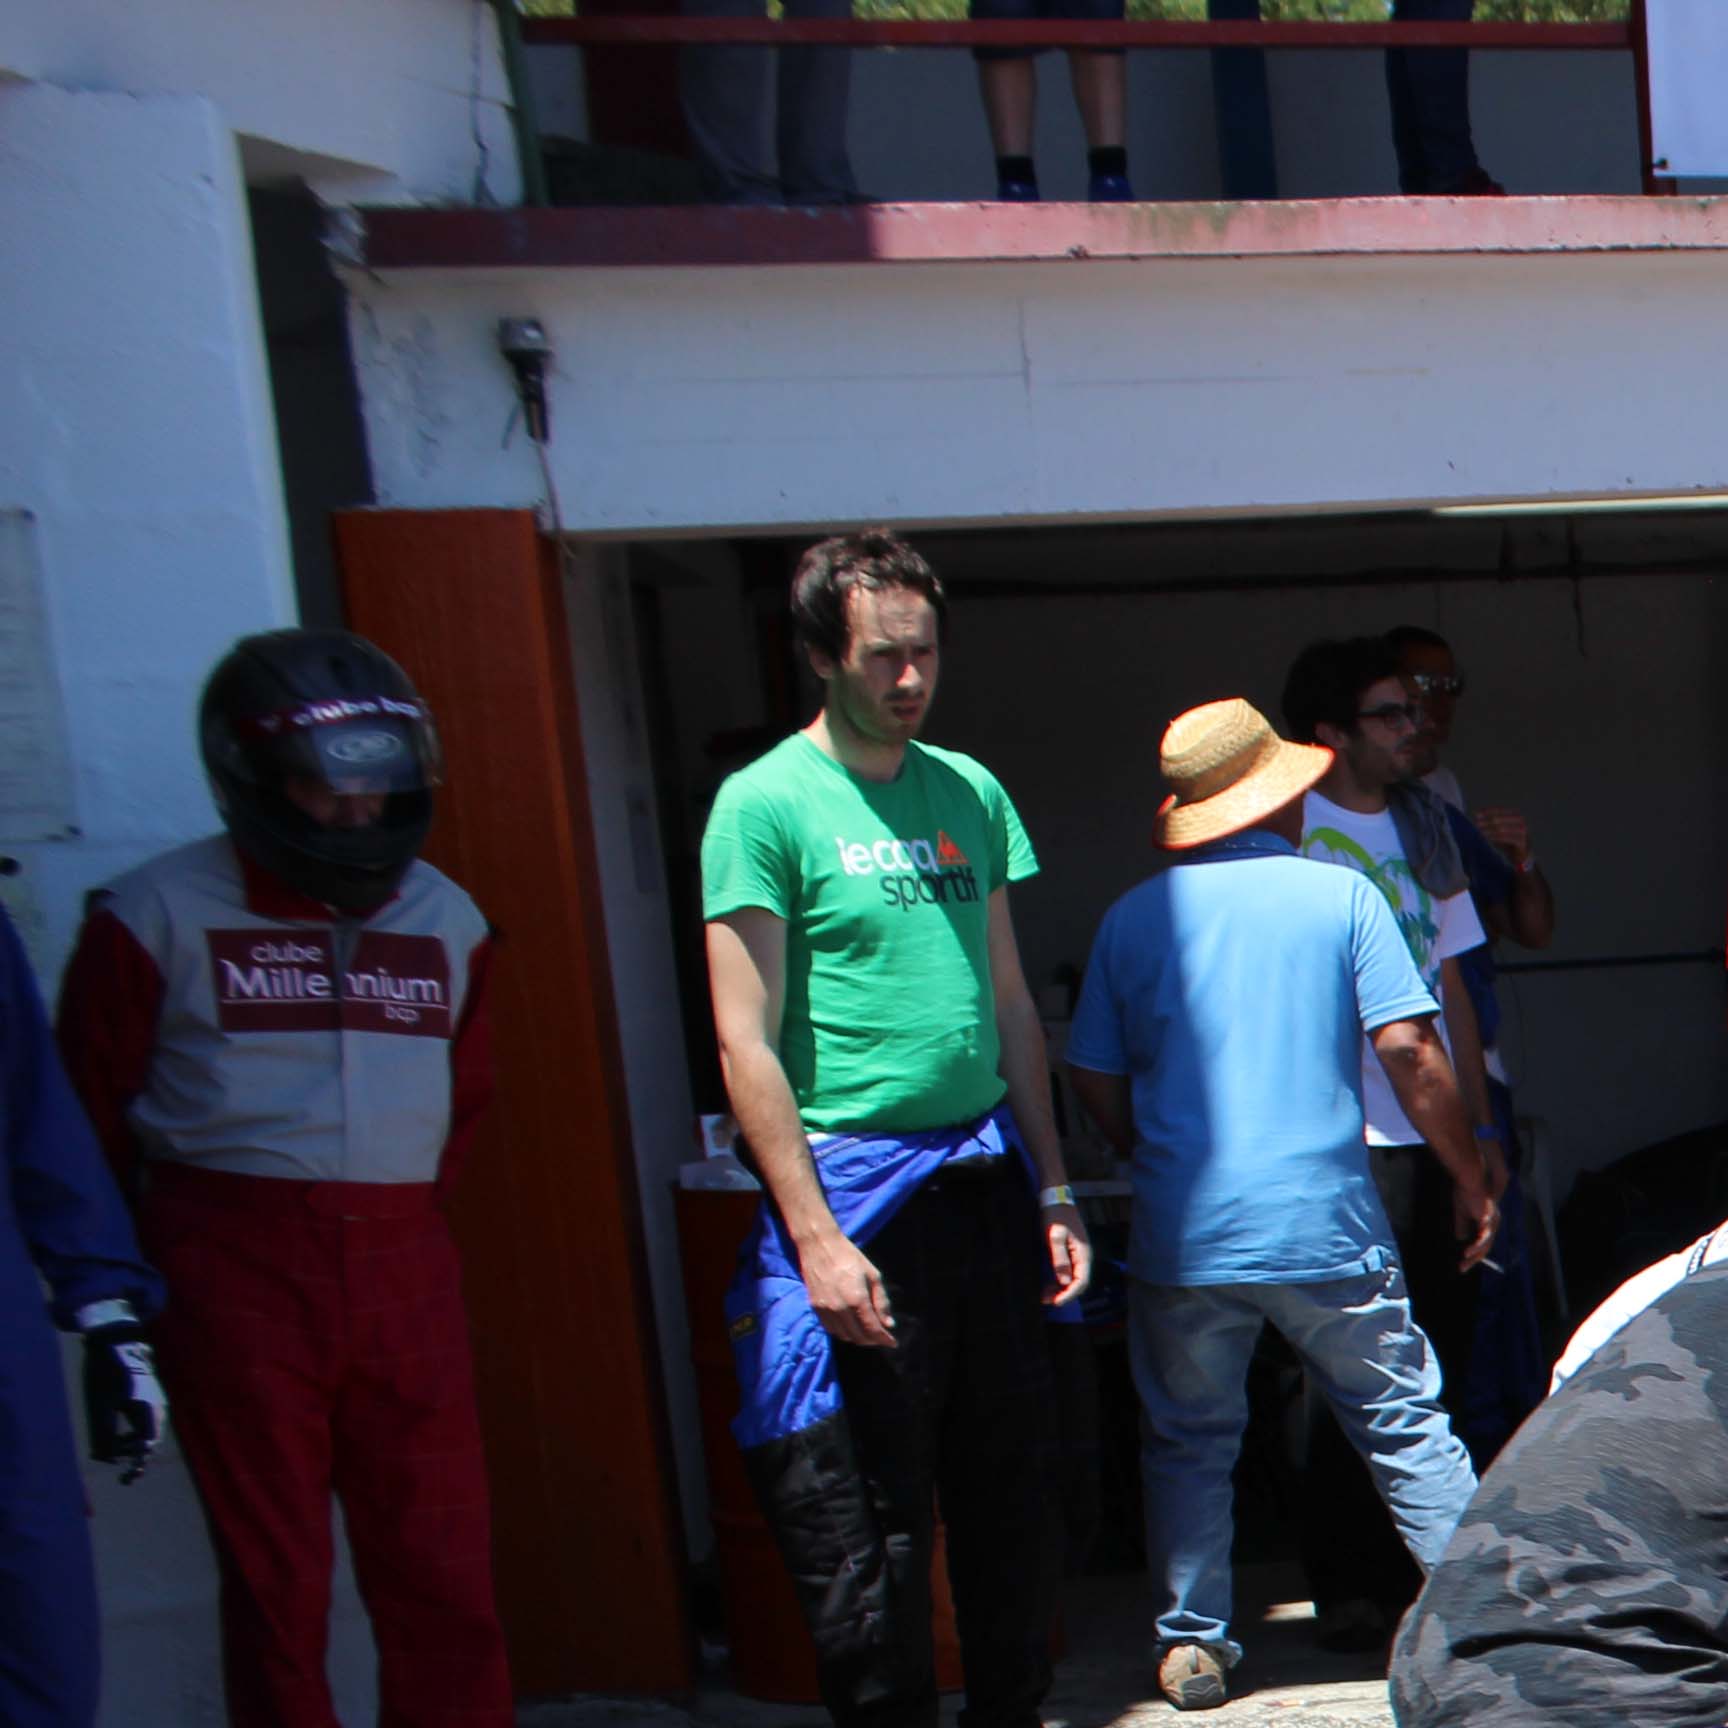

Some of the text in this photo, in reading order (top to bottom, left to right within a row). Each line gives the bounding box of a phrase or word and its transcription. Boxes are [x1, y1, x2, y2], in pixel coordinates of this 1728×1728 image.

[881, 865, 980, 912] sportif
[249, 941, 325, 964] clube
[384, 1002, 422, 1024] bcp
